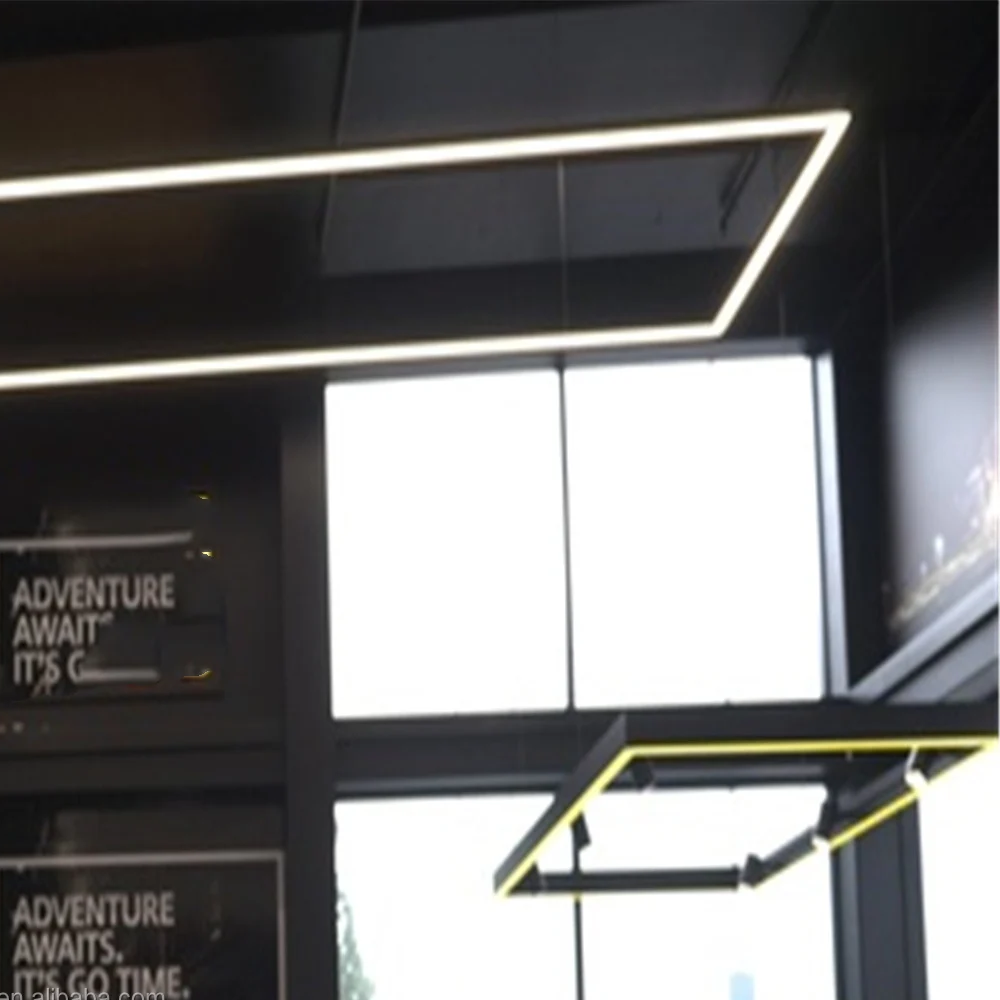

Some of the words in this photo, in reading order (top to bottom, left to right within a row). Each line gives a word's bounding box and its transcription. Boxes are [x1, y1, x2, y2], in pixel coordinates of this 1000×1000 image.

[12, 573, 176, 611] ADVENTURE
[12, 611, 114, 647] AWAIT
[13, 651, 61, 685] IT'S
[12, 891, 175, 929] ADVENTURE
[12, 930, 124, 965] AWAITS.
[13, 969, 60, 1000] IT'S
[67, 968, 110, 1000] GO
[115, 966, 191, 1000] TIME.
